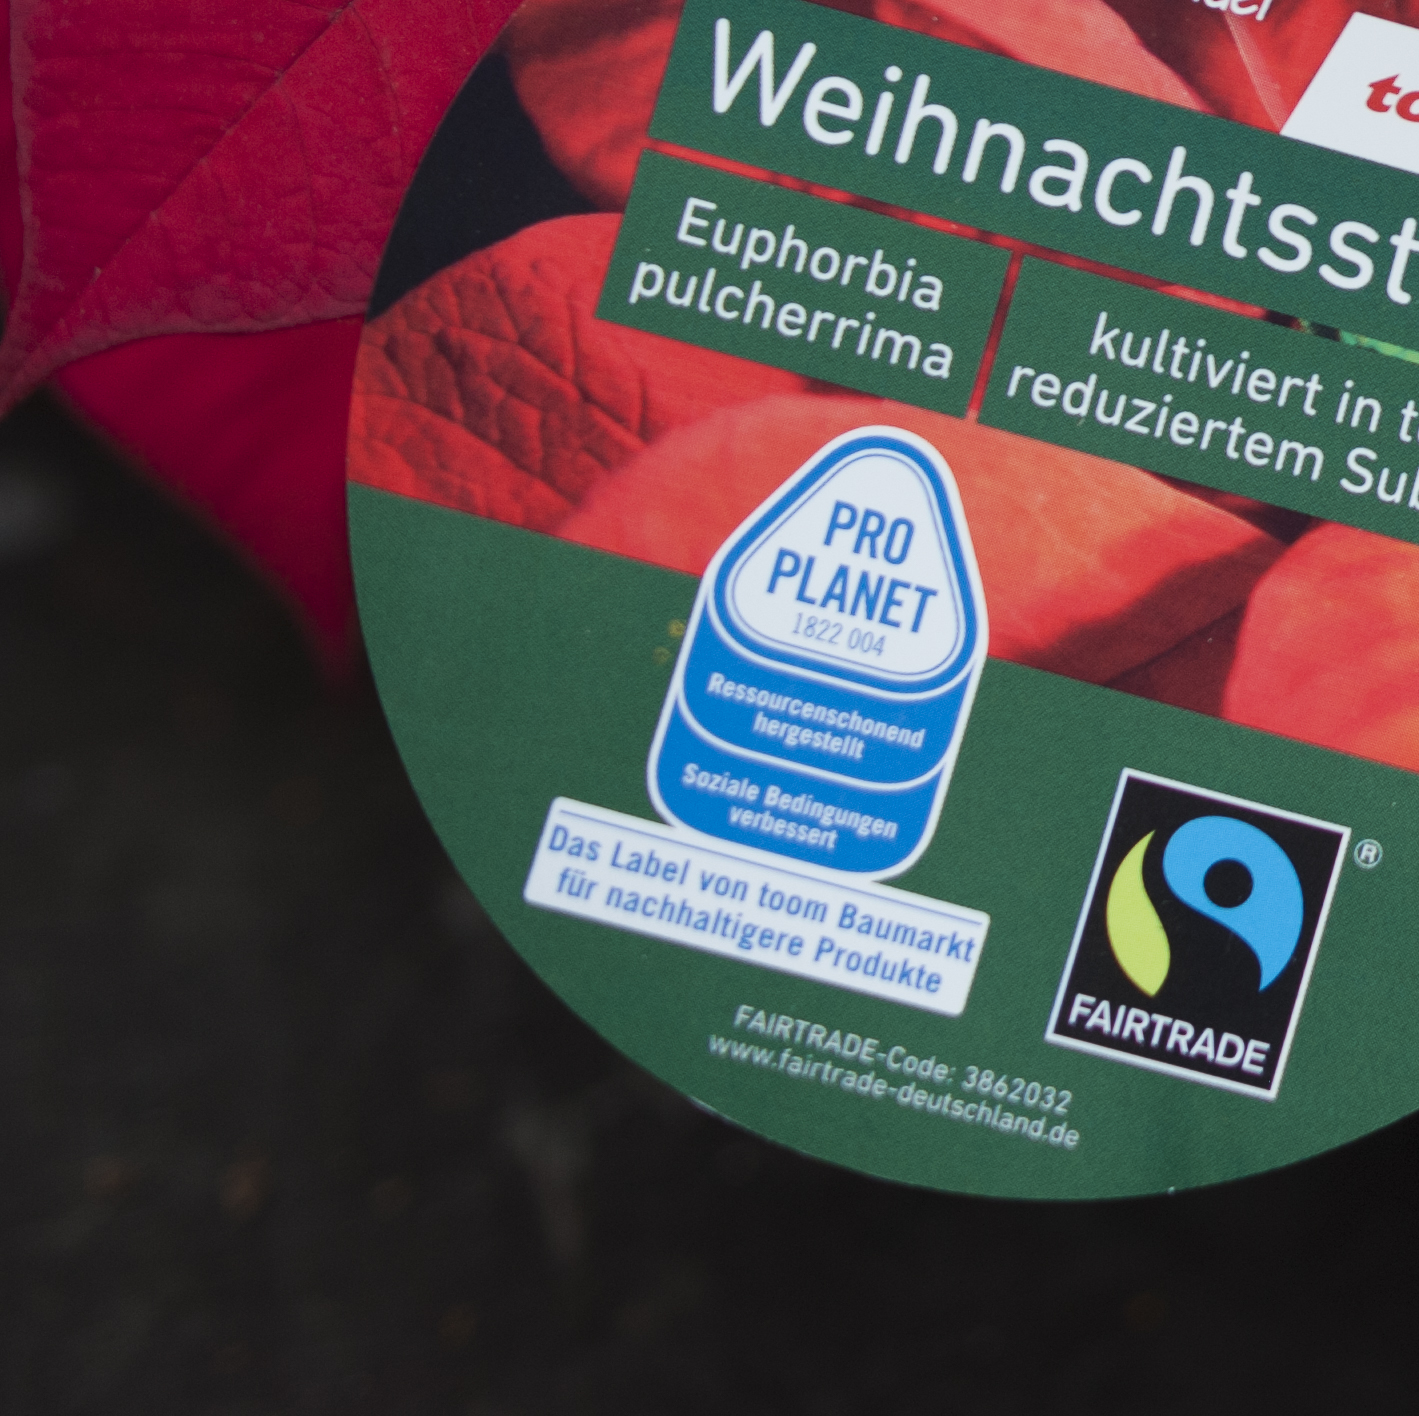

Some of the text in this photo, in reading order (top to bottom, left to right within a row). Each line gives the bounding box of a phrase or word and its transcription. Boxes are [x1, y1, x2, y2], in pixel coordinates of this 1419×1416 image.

[676, 196, 944, 312] Euphorbia
[629, 261, 954, 380] pulcherrima
[1006, 362, 1325, 481] reduziertem
[1089, 311, 1325, 417] kultiviert
[1335, 380, 1383, 433] in
[822, 499, 915, 565] PRO
[766, 547, 939, 633] PLANET
[791, 612, 888, 657] 1822 004
[706, 670, 926, 749] Ressourcenschonend
[752, 712, 866, 760] hergestellt
[681, 762, 899, 839] Soziale Bedingungen
[728, 805, 839, 850] verbessert
[547, 824, 976, 964] Das Label von toom Baumarkt
[556, 867, 943, 994] für nachhaltigere Produkte
[733, 1003, 1074, 1116] FAIRTRADE-Code: 3862032
[1068, 993, 1271, 1075] FAIRTRADE
[707, 1033, 1082, 1151] www.fairtrade-deutschland.de
